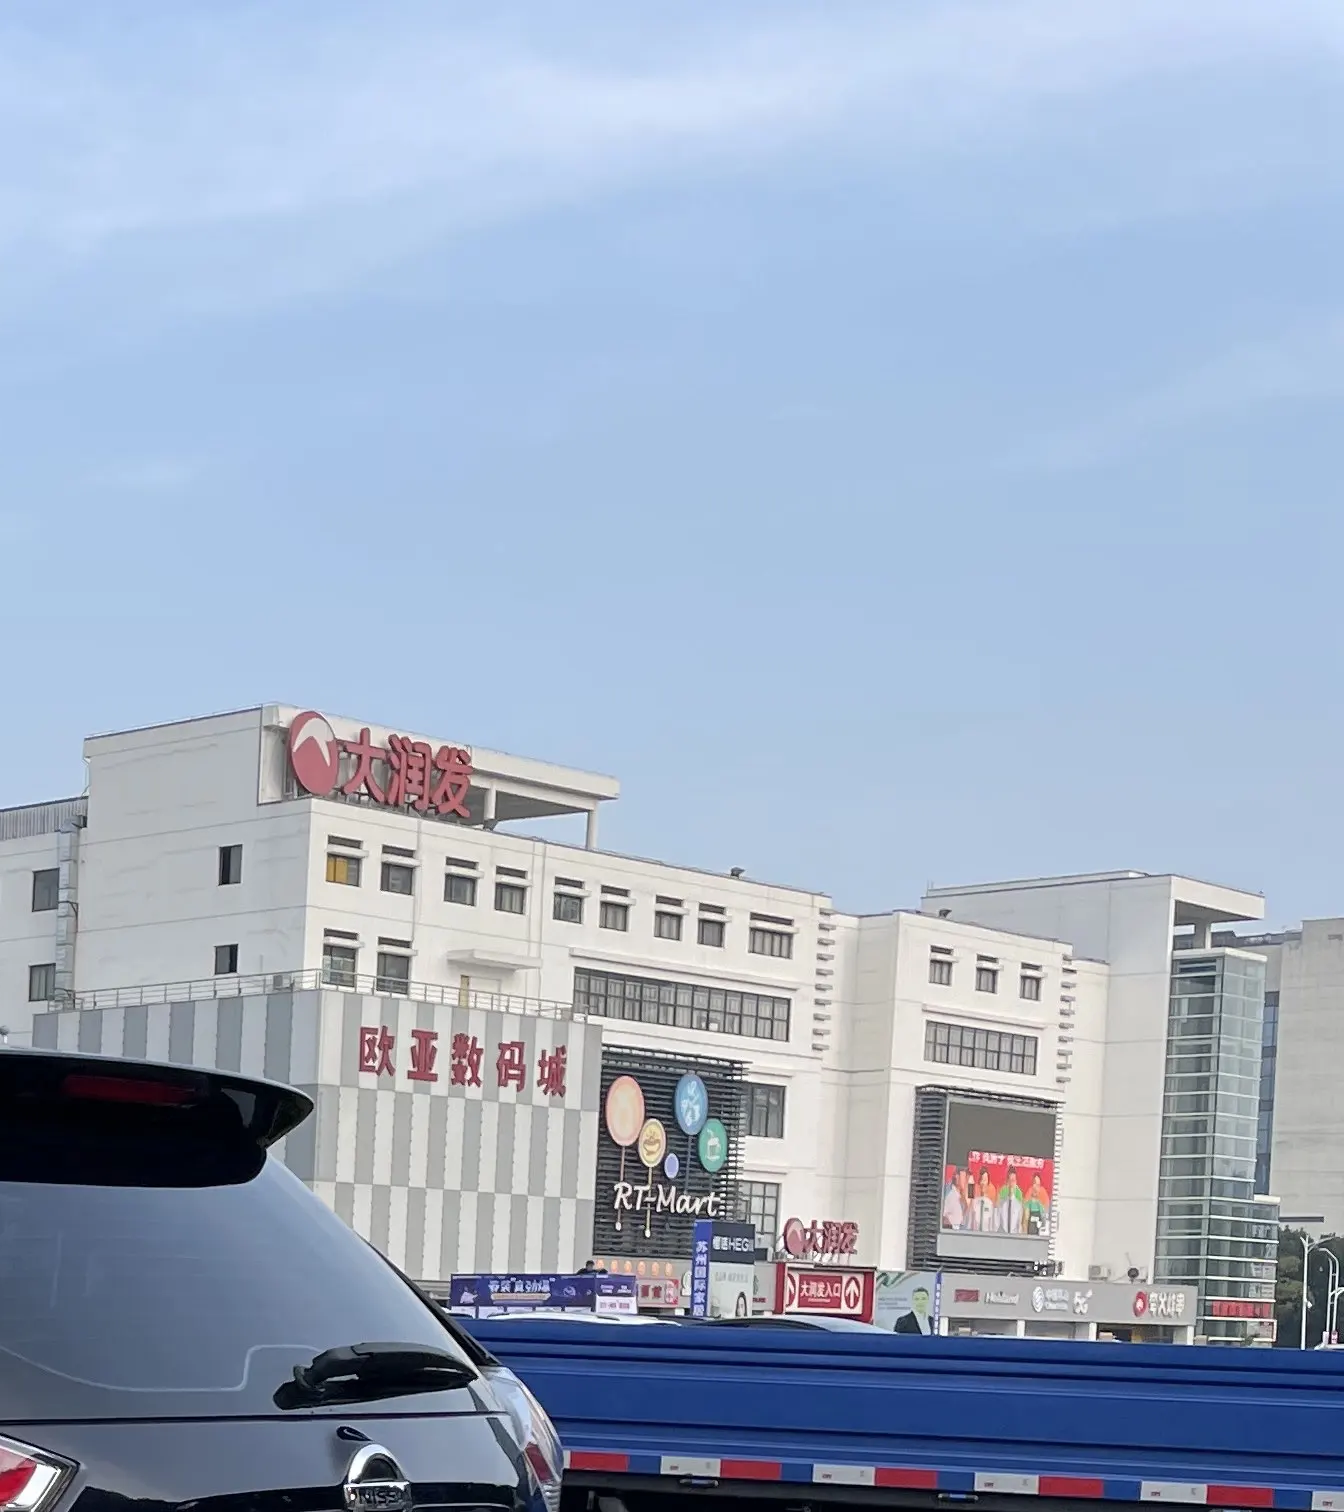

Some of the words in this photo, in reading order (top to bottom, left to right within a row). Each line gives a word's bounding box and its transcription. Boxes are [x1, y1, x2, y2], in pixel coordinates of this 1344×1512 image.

[336, 727, 474, 819] 大润发
[359, 1025, 567, 1098] 欧亚数码城
[613, 1181, 722, 1217] RT-Mart
[804, 1220, 859, 1255] 大润发
[800, 1282, 842, 1298] 大润发入口
